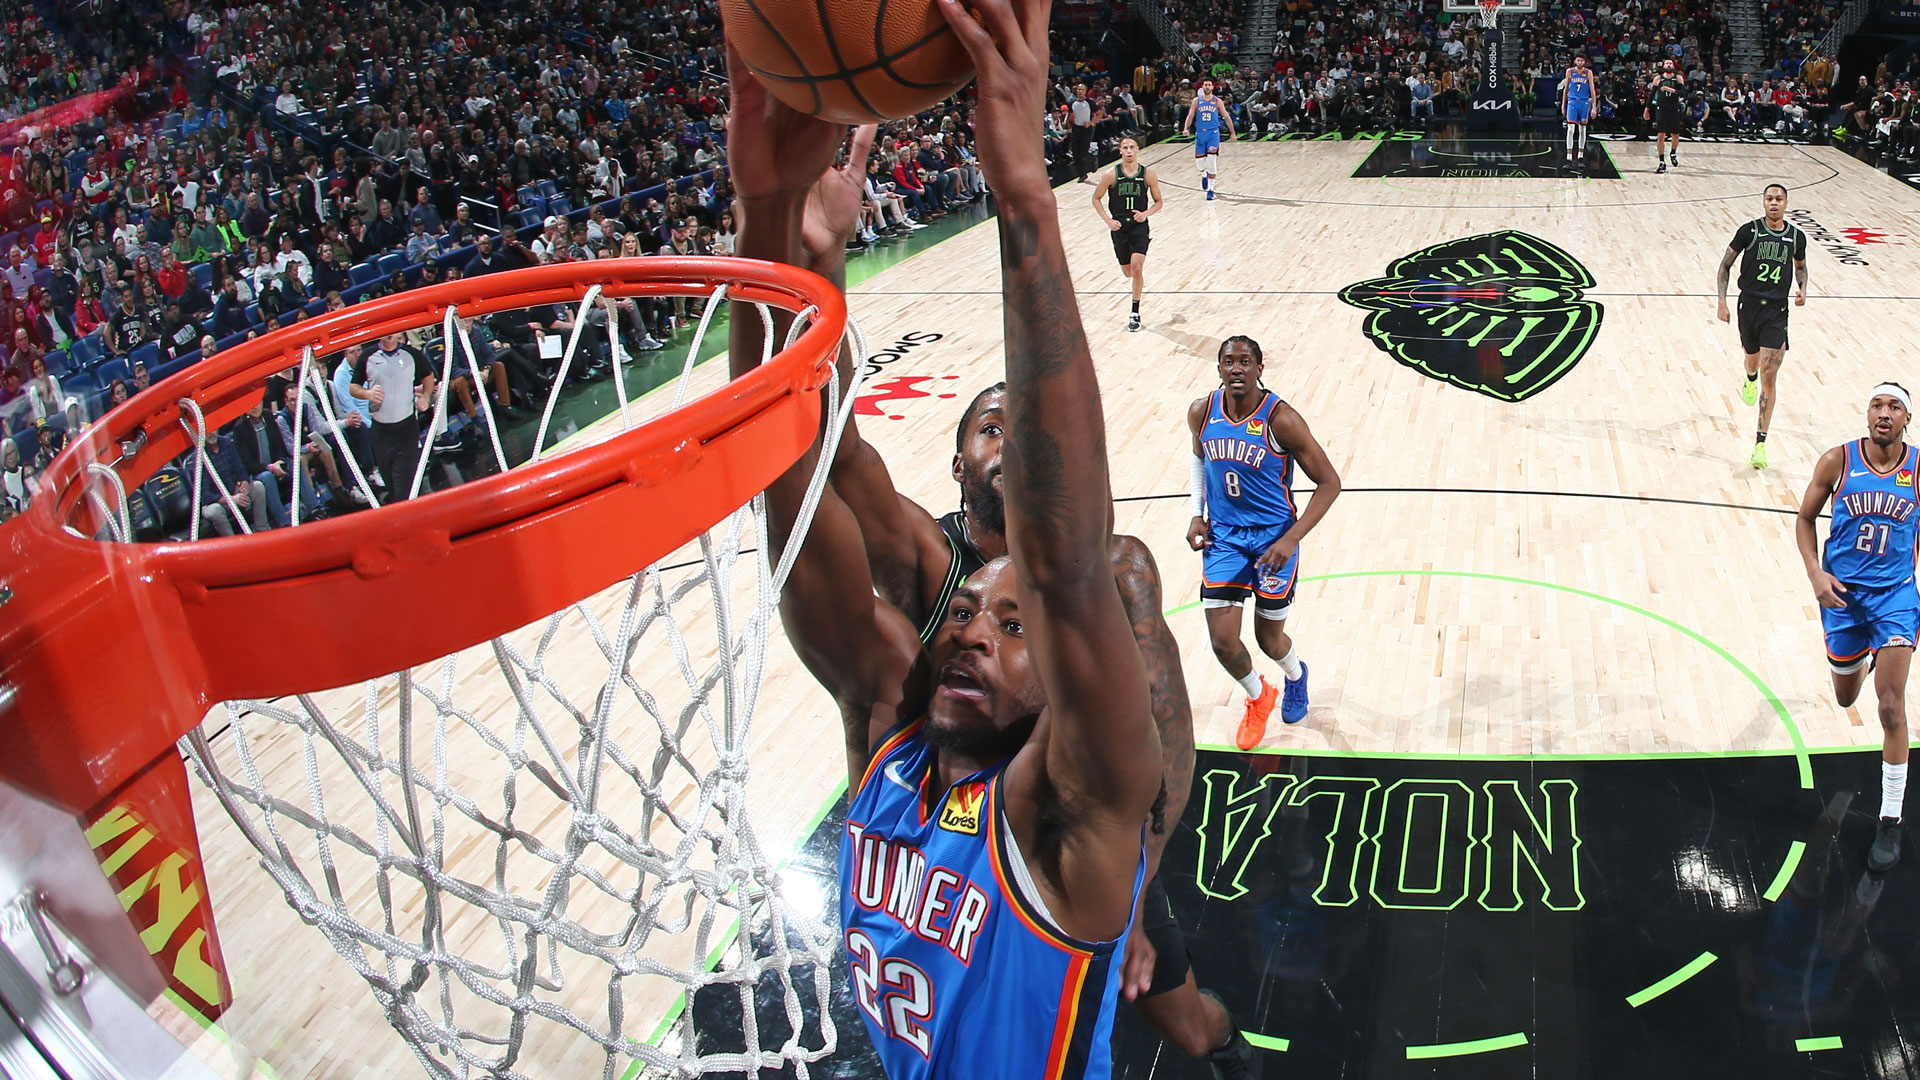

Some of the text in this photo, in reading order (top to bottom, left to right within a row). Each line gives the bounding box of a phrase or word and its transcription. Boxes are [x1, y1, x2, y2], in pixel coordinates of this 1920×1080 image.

[1489, 68, 1497, 89] COX
[1576, 84, 1582, 92] 7
[1198, 105, 1217, 113] THUNDER
[1473, 100, 1512, 110] KIA
[1201, 112, 1212, 122] 29
[1157, 131, 1426, 144] PLICANS
[1118, 182, 1142, 197] NOLA
[1126, 197, 1135, 210] 11
[1756, 241, 1789, 265] NOLA
[1820, 243, 1870, 266] KING
[1756, 263, 1782, 284] 24
[1202, 437, 1267, 468] THUNDER
[1224, 470, 1242, 498] 8
[1842, 490, 1915, 523] THUNDER
[1855, 522, 1890, 556] 21
[1196, 769, 1586, 911] NOLA
[846, 819, 990, 968] TUNDER
[845, 927, 935, 1063] 22
